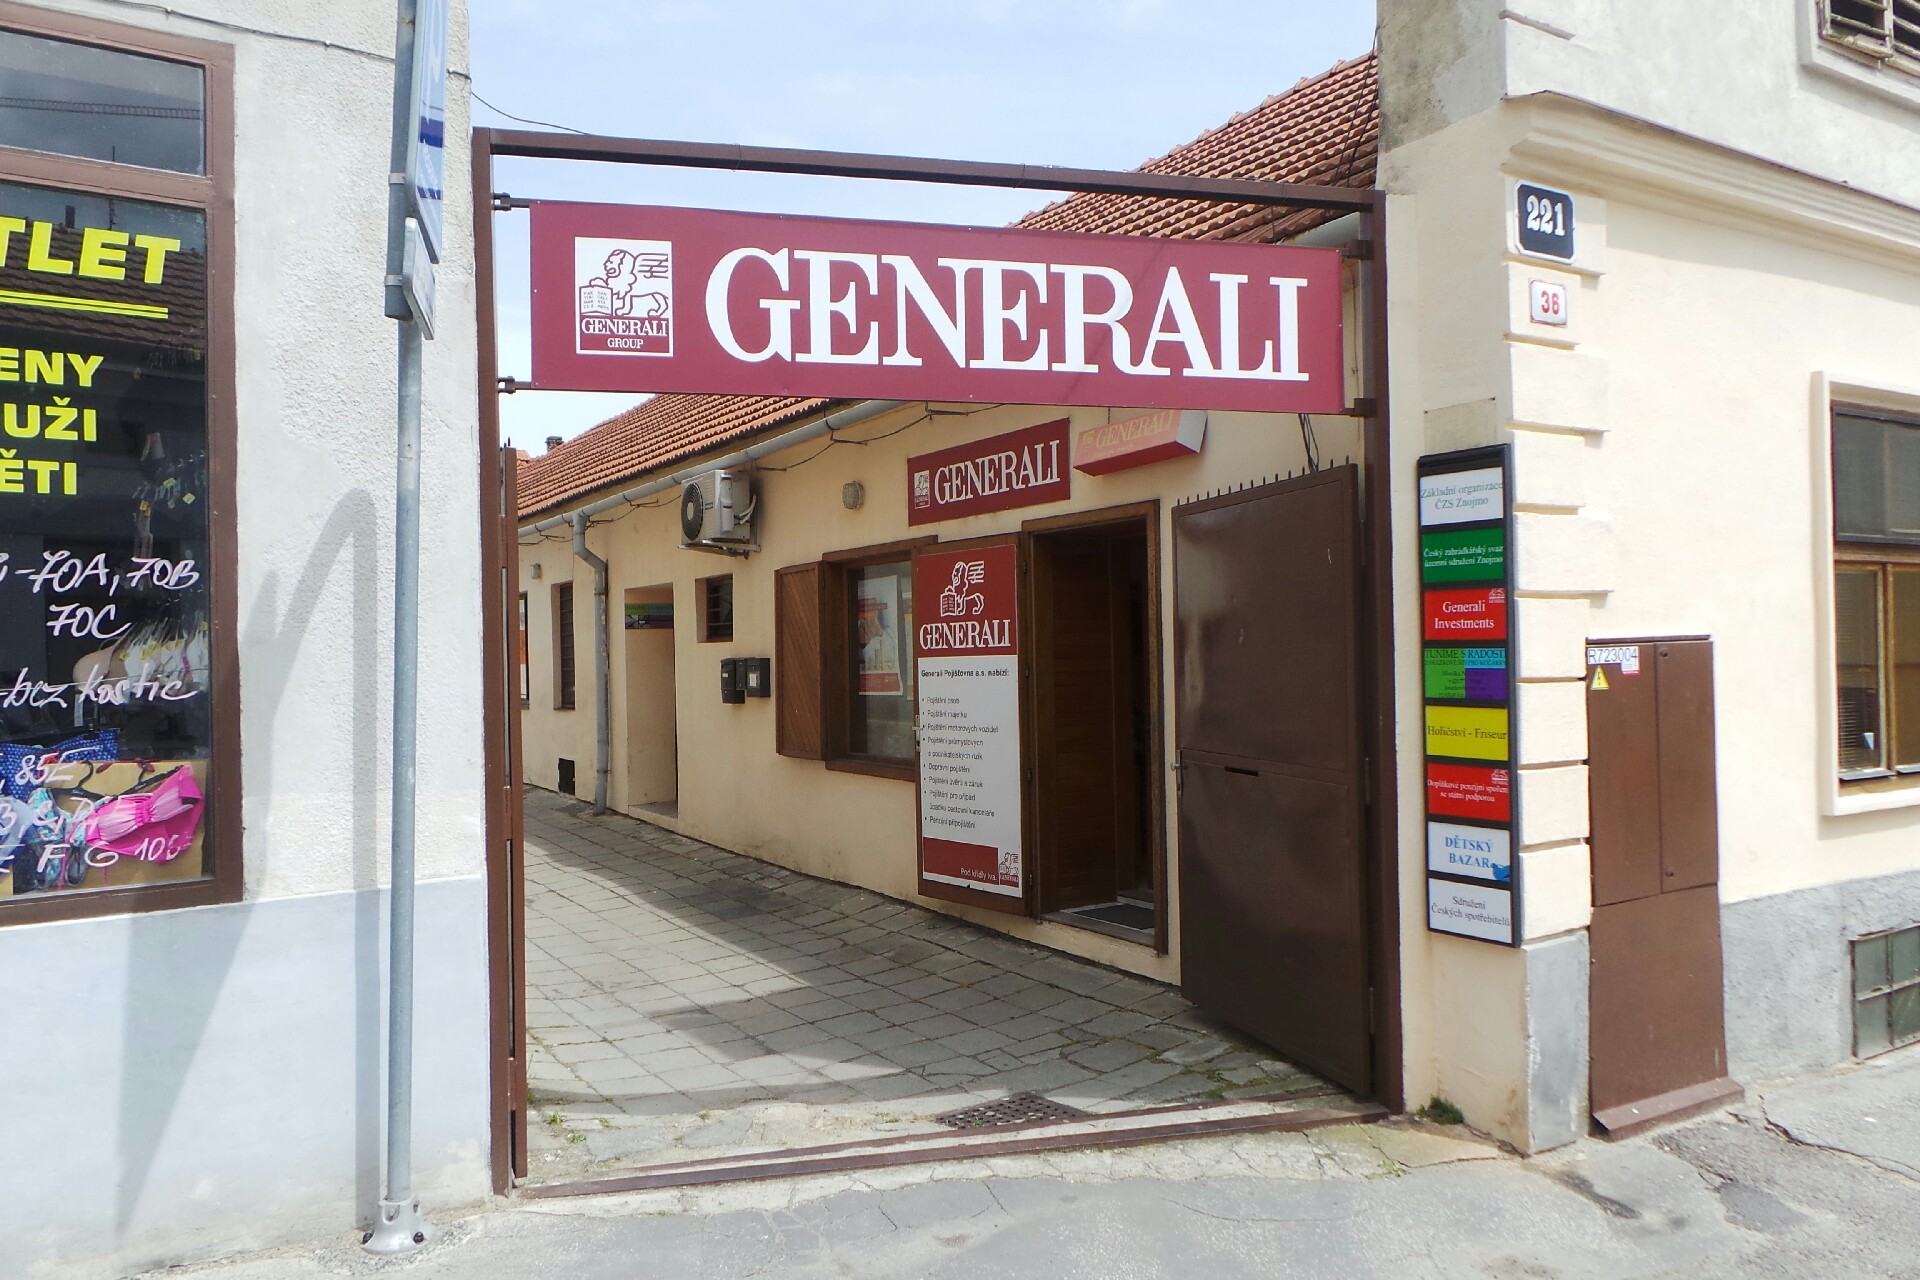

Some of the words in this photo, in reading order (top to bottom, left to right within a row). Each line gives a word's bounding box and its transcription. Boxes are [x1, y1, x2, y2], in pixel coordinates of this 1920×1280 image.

[1526, 195, 1565, 236] 221
[1541, 290, 1559, 314] 36
[705, 247, 1309, 381] GENERALI
[581, 317, 668, 336] GENERALI
[607, 337, 644, 348] GROUP
[1096, 410, 1174, 448] GENERALI
[934, 439, 1061, 505] GENERALI
[1456, 496, 1488, 508] Znojmo
[1477, 555, 1503, 565] Znojmo
[1442, 600, 1485, 614] Generali
[46, 603, 132, 639] 70C
[1434, 617, 1495, 630] Investments
[919, 619, 1011, 650] GENERALI
[1588, 648, 1637, 664] R723004
[921, 669, 943, 678] Generali
[1474, 727, 1507, 740] Friseur
[1445, 835, 1494, 853] DĚTSKÝ
[1449, 852, 1490, 868] BAZAR
